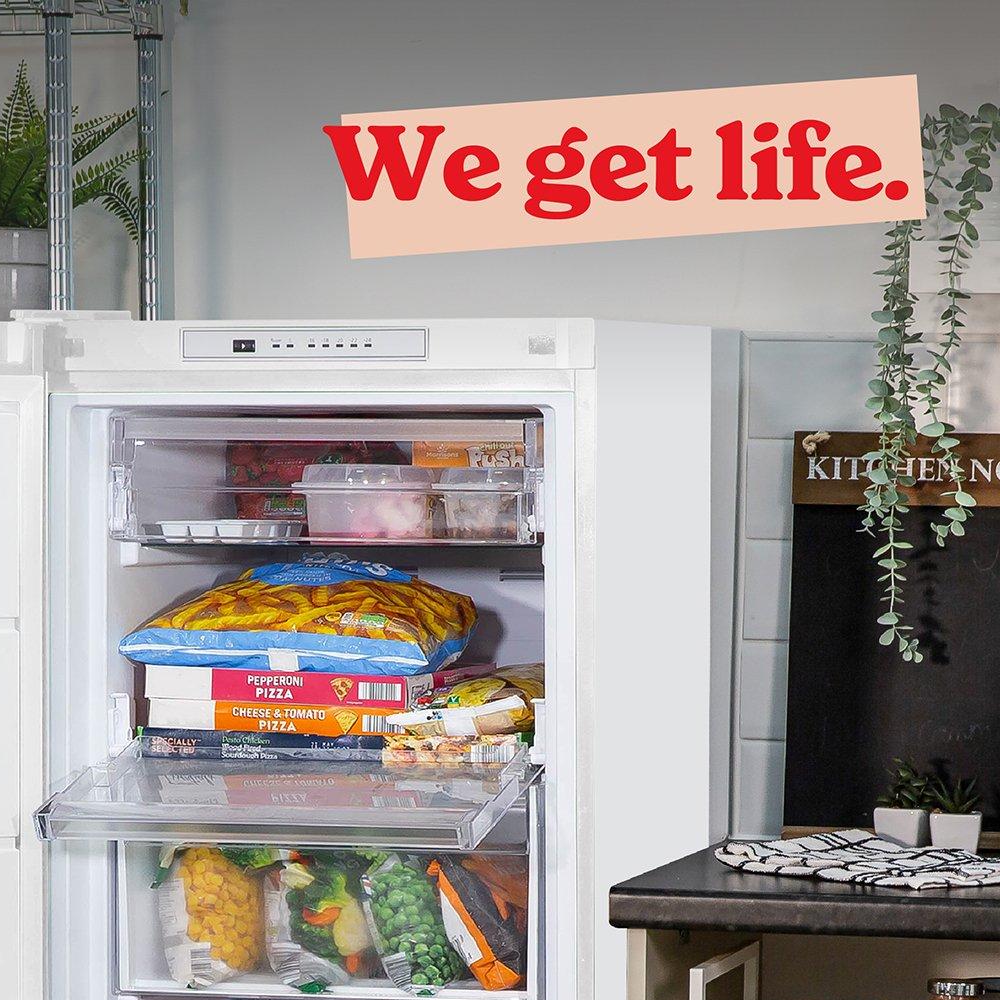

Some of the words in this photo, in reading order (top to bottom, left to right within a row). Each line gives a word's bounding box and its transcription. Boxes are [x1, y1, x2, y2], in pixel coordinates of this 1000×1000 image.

[969, 458, 1000, 483] N
[247, 675, 303, 687] PEPPERONI
[256, 688, 293, 699] PIZZA
[232, 707, 271, 718] CHEESE
[273, 708, 281, 718] &
[284, 708, 326, 720] TOMATO
[259, 720, 297, 732] PIZZA
[151, 736, 197, 746] SPECIALLY
[222, 736, 241, 744] Pesto
[242, 736, 270, 745] Chicken
[151, 746, 195, 754] SELECTED
[221, 751, 260, 760] Sourdough
